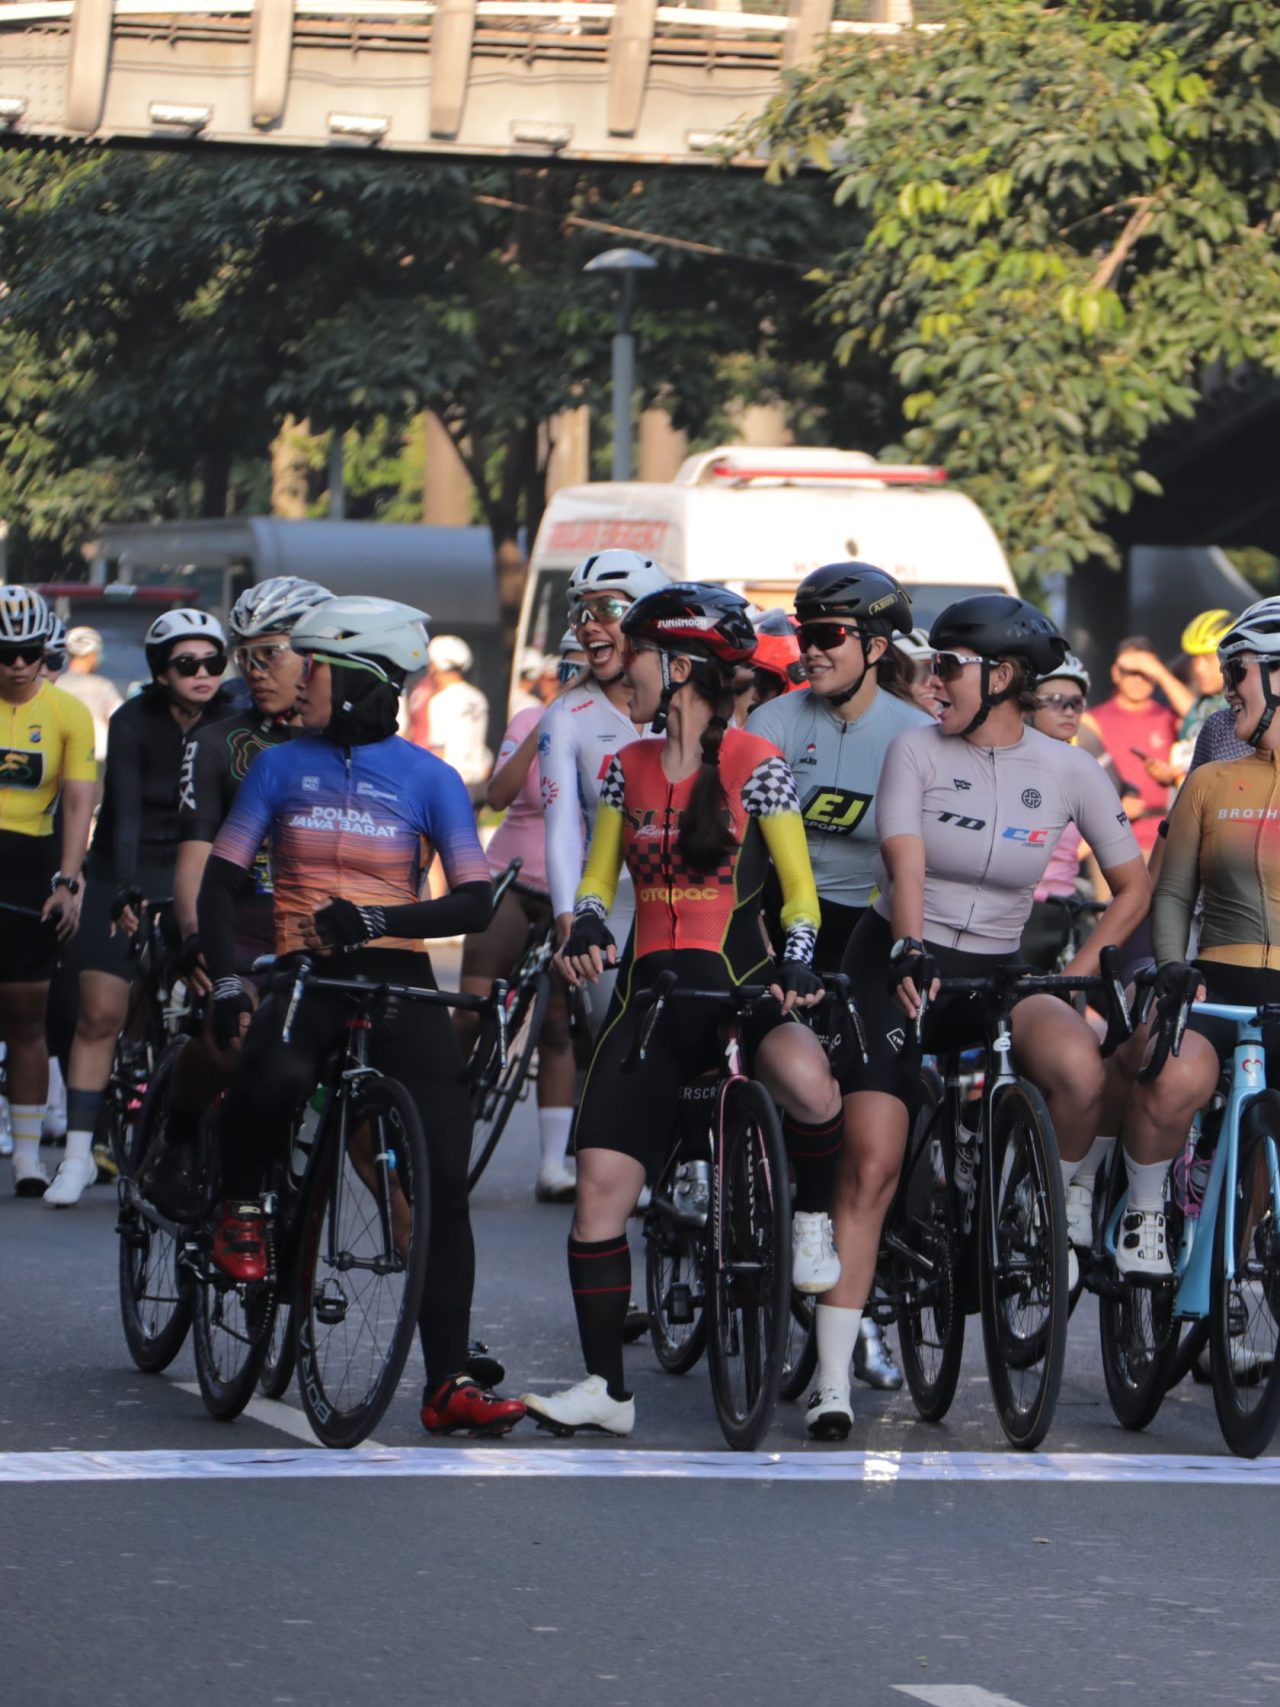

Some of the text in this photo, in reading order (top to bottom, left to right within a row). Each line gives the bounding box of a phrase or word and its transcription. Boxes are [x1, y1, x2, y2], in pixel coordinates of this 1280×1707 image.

[310, 806, 375, 826] POLDA
[804, 793, 865, 827] EJ
[287, 815, 398, 838] JAWA BARAT
